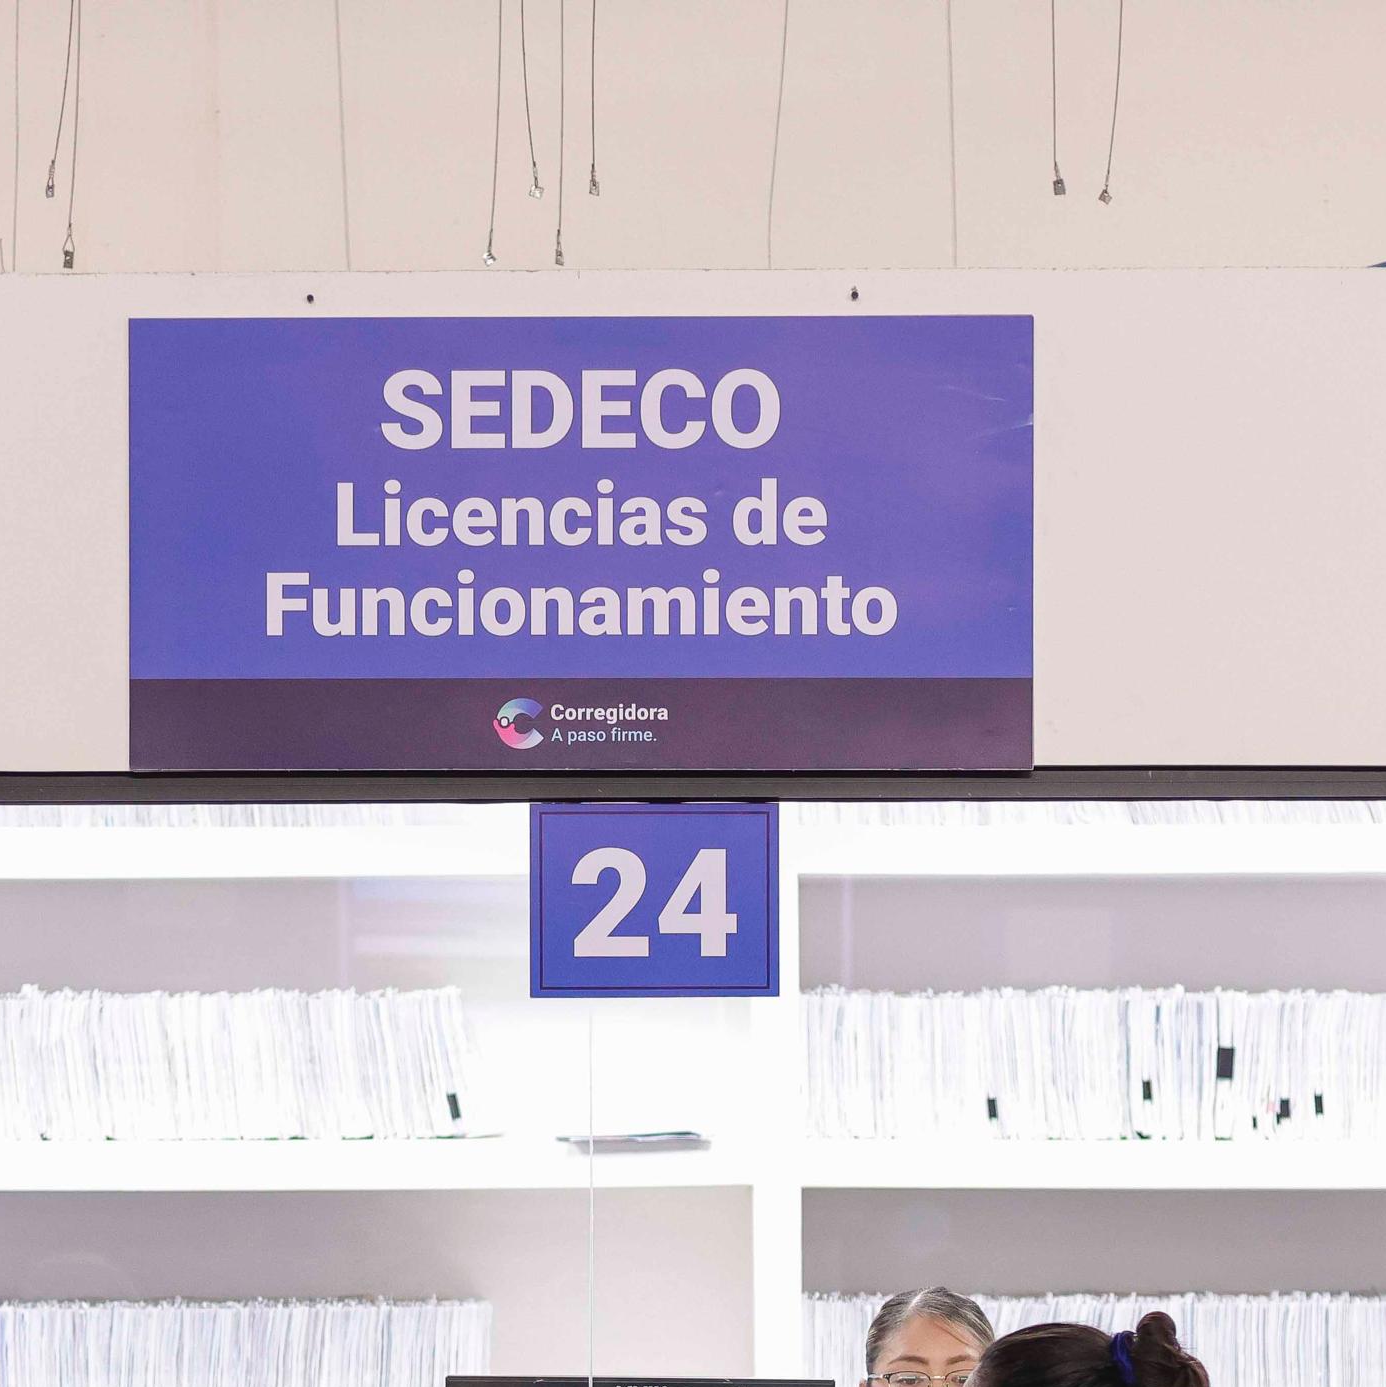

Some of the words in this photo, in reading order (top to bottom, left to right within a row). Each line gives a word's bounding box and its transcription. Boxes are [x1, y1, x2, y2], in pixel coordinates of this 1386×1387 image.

[380, 367, 782, 451] SEDECO
[335, 478, 708, 548] Licencias
[732, 477, 829, 548] de
[264, 569, 900, 637] Funcionamiento
[550, 703, 669, 725] Corregidora
[550, 727, 564, 742] A
[567, 730, 607, 746] paso
[610, 726, 658, 742] firme.
[571, 846, 738, 957] 24
